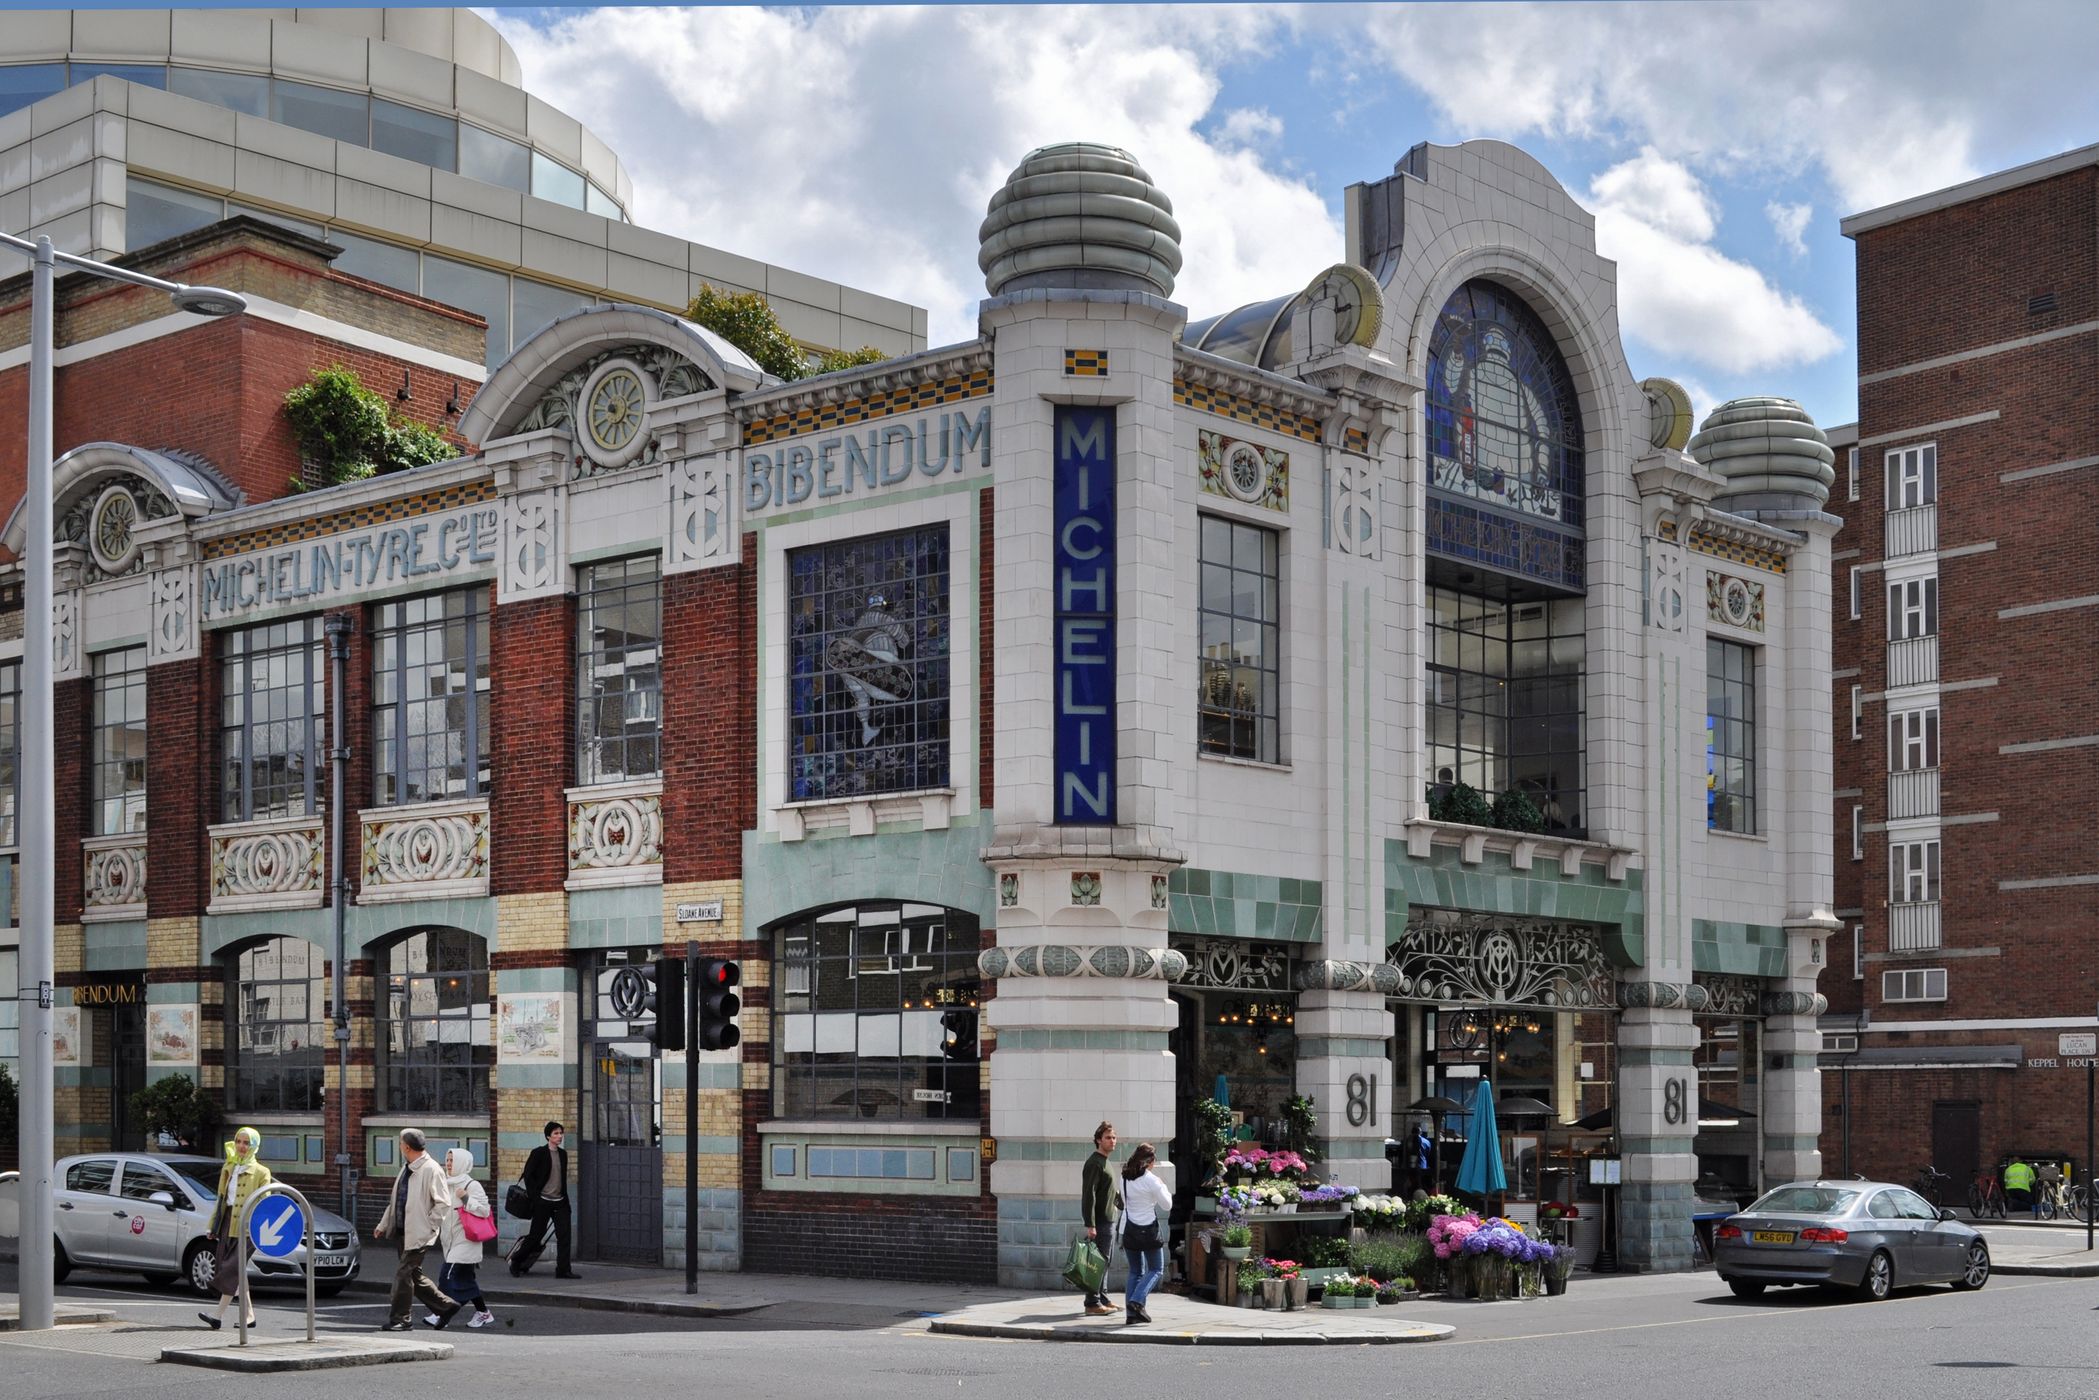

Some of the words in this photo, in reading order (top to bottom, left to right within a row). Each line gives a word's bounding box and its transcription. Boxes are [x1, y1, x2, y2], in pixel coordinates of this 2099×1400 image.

[746, 405, 991, 512] BIBENDUM
[1061, 416, 1108, 817] MICHELIN
[2028, 1058, 2060, 1067] KEPPEL
[1346, 1072, 1376, 1127] 81
[1664, 1077, 1687, 1125] 81
